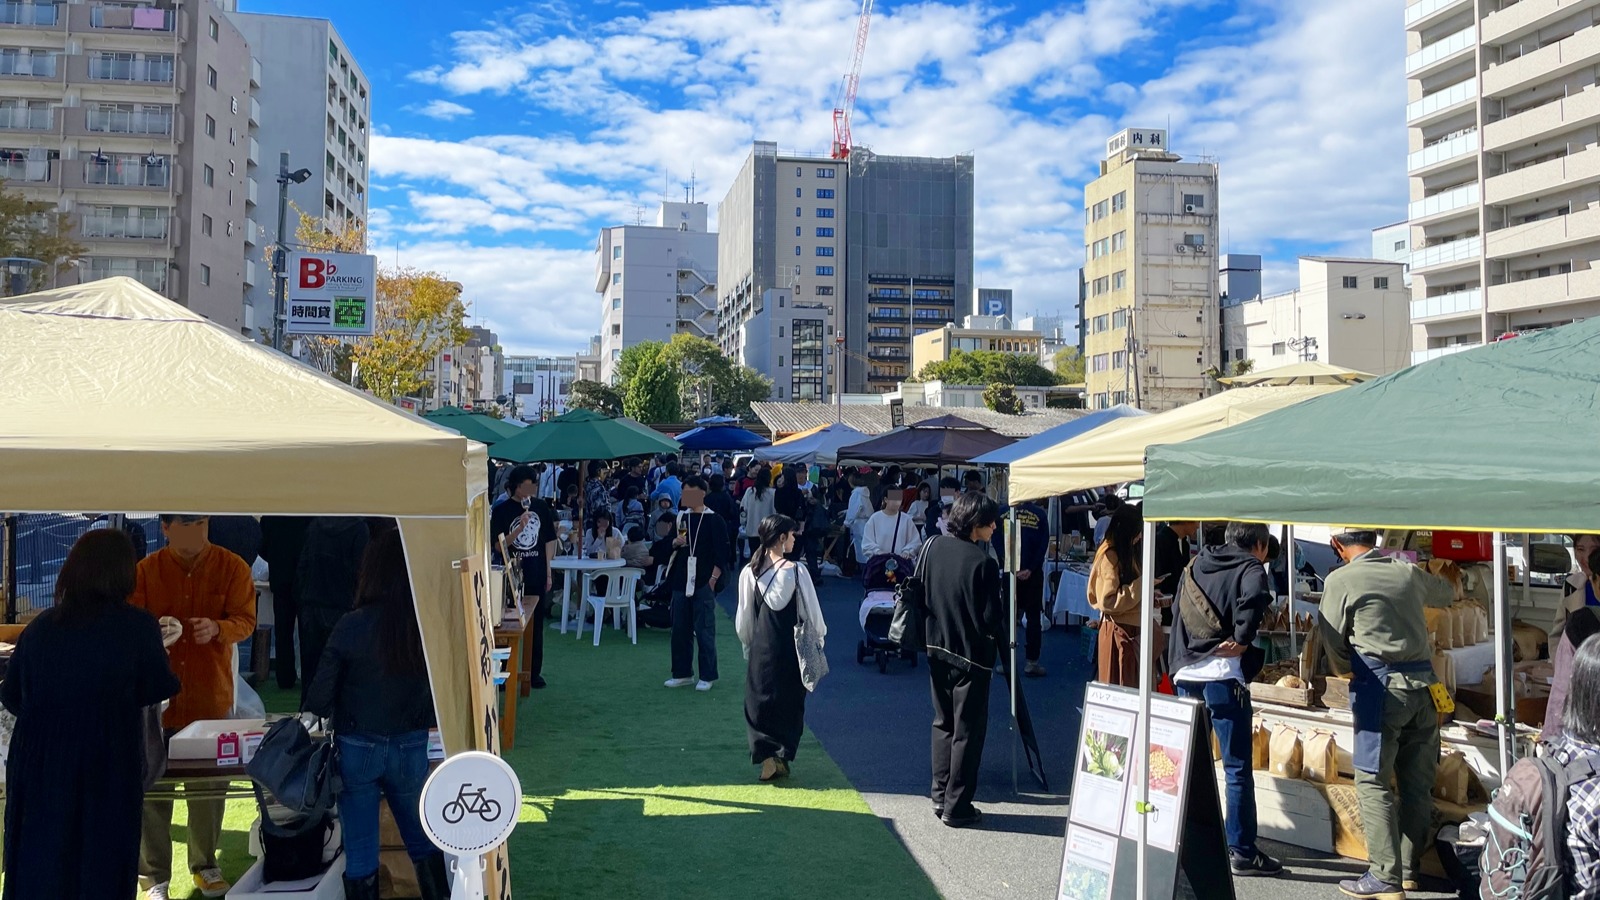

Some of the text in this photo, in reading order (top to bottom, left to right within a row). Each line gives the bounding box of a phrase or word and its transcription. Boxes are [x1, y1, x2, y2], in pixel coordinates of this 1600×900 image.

[1133, 132, 1160, 145] 内科
[326, 276, 363, 284] PARKING
[291, 305, 331, 319] 時間貸
